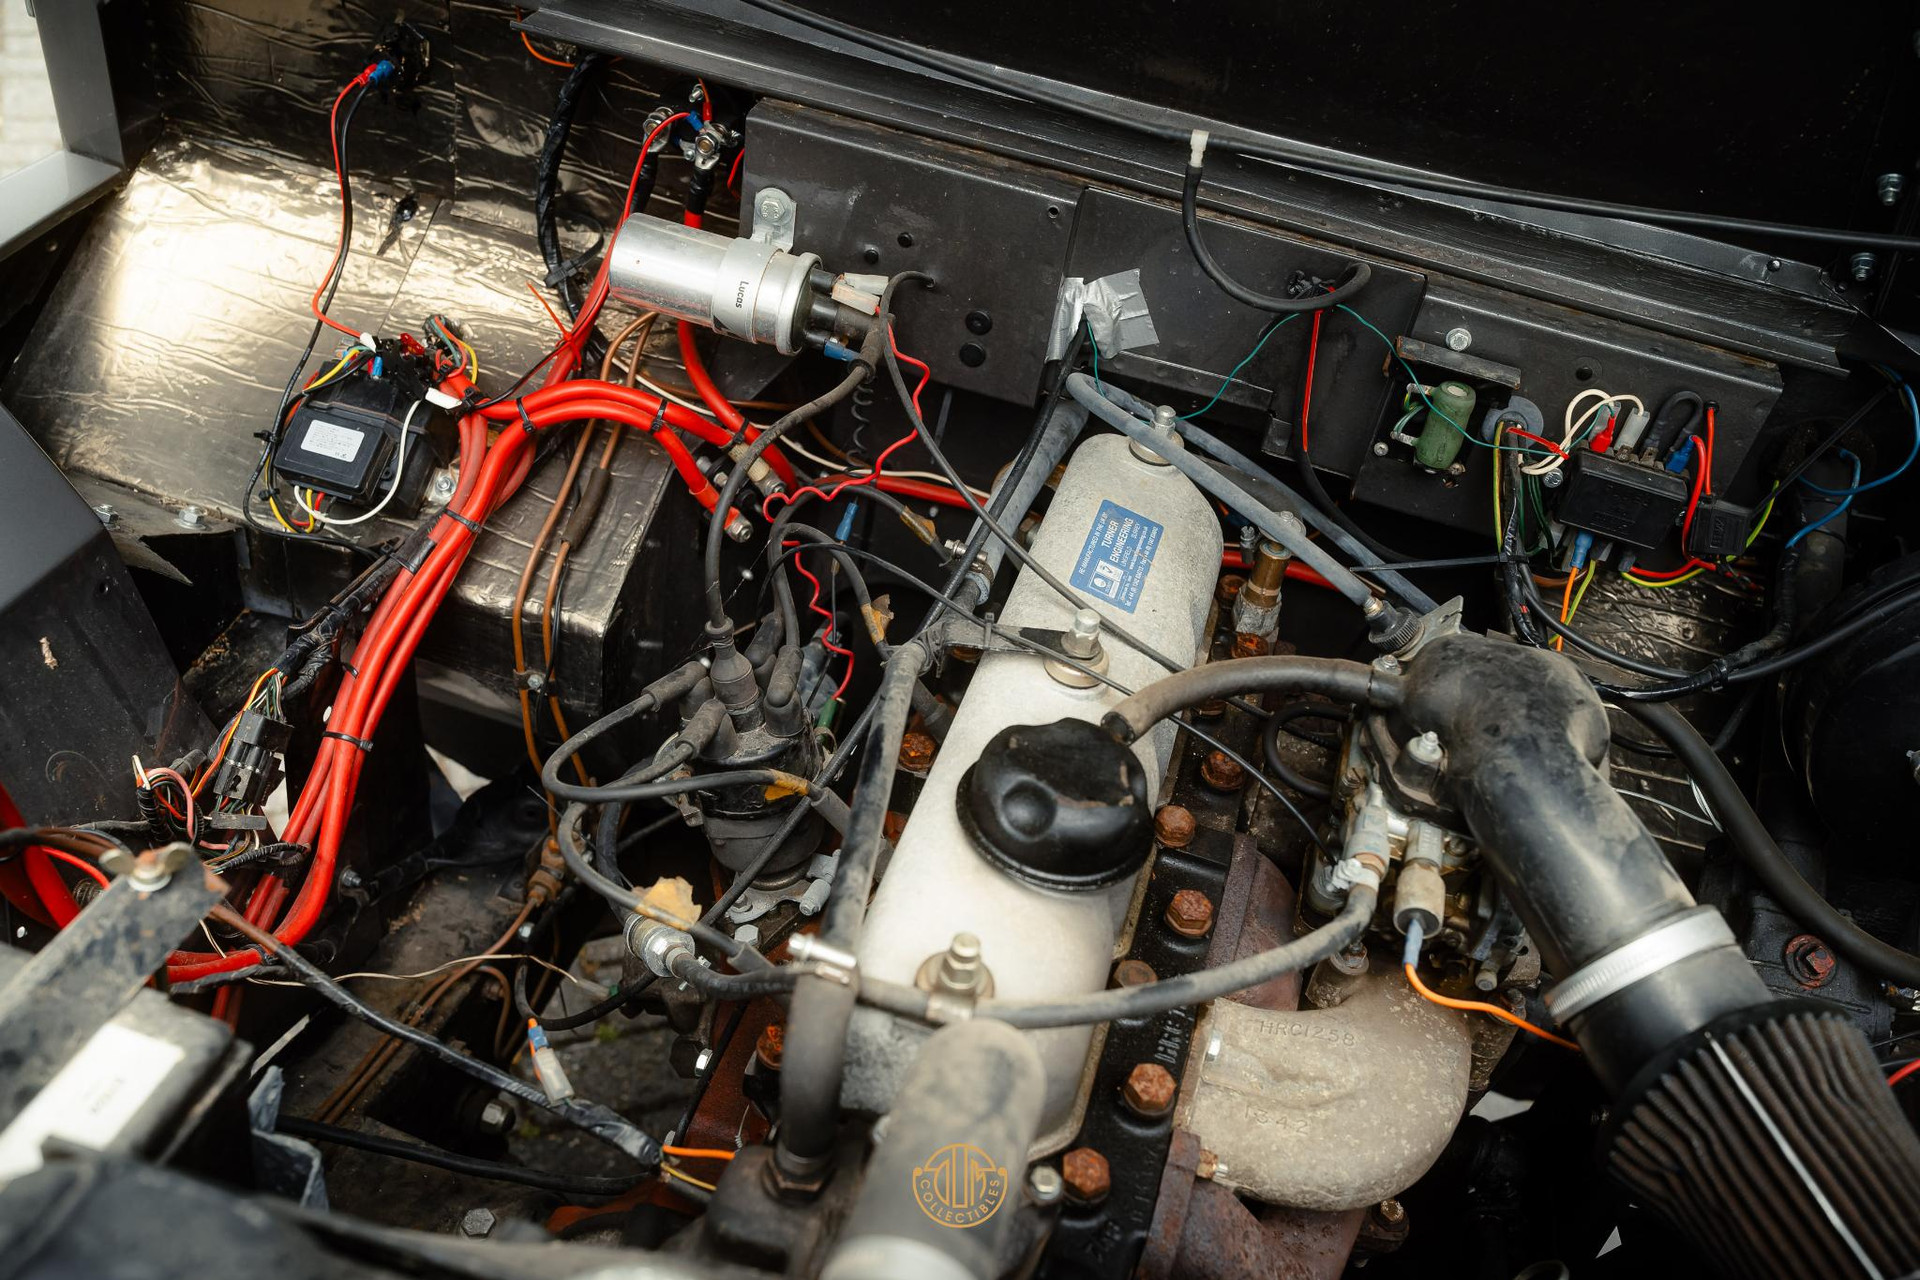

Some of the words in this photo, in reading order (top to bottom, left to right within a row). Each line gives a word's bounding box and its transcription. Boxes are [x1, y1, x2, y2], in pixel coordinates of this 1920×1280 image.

[735, 280, 749, 308] Lucas
[1101, 520, 1119, 548] TURNER
[1110, 517, 1134, 563] ENGINEERING
[1260, 1020, 1355, 1046] HRC1258
